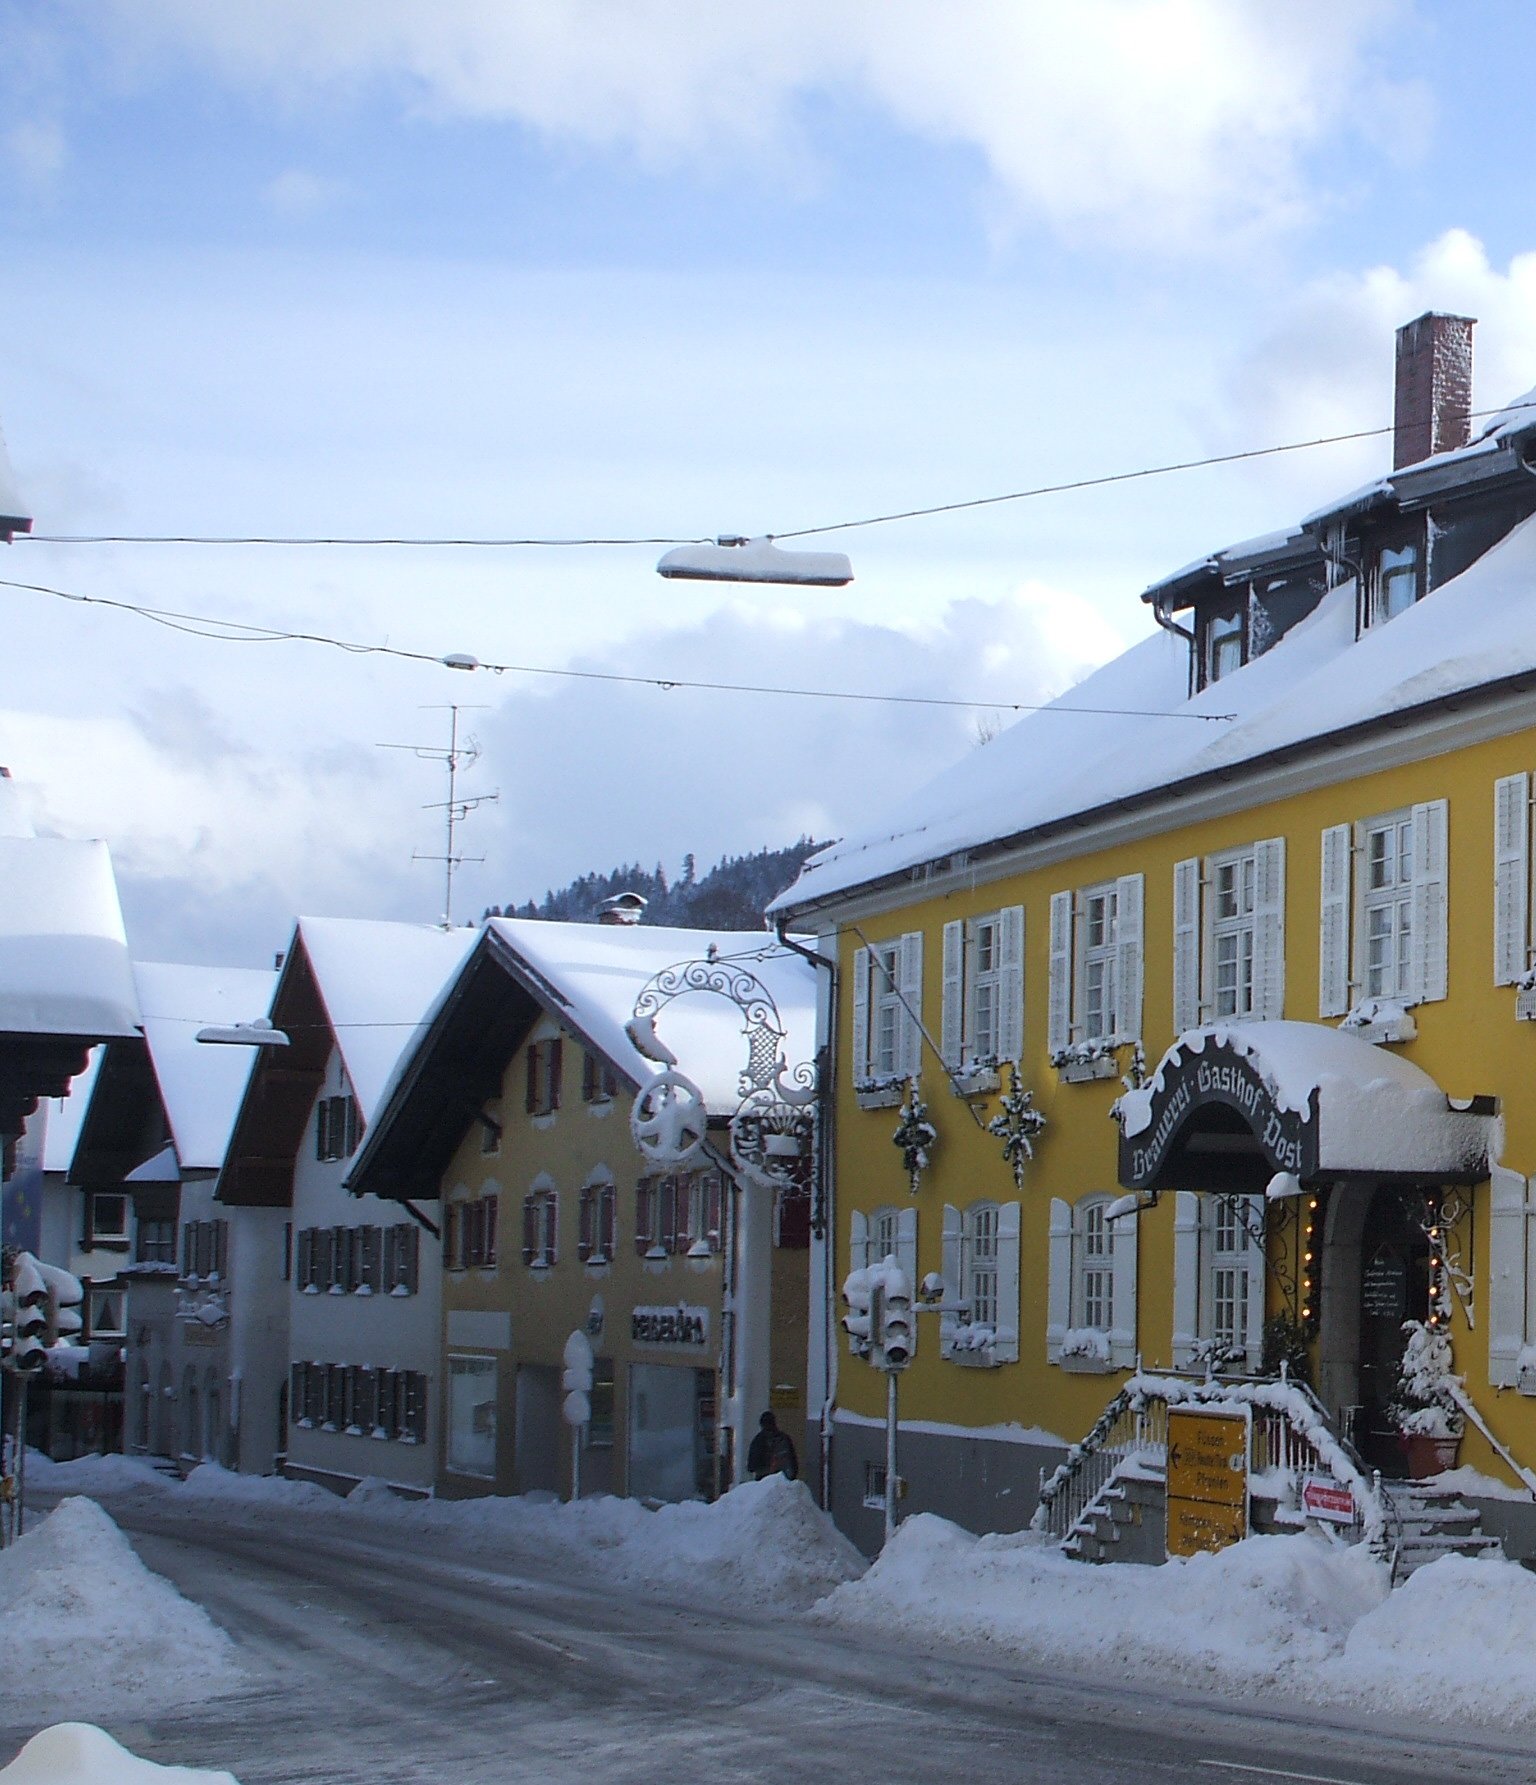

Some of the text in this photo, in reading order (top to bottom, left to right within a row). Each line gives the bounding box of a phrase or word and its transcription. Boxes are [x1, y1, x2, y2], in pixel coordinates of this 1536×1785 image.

[1132, 1060, 1303, 1181] Brauerei Gasthof Post
